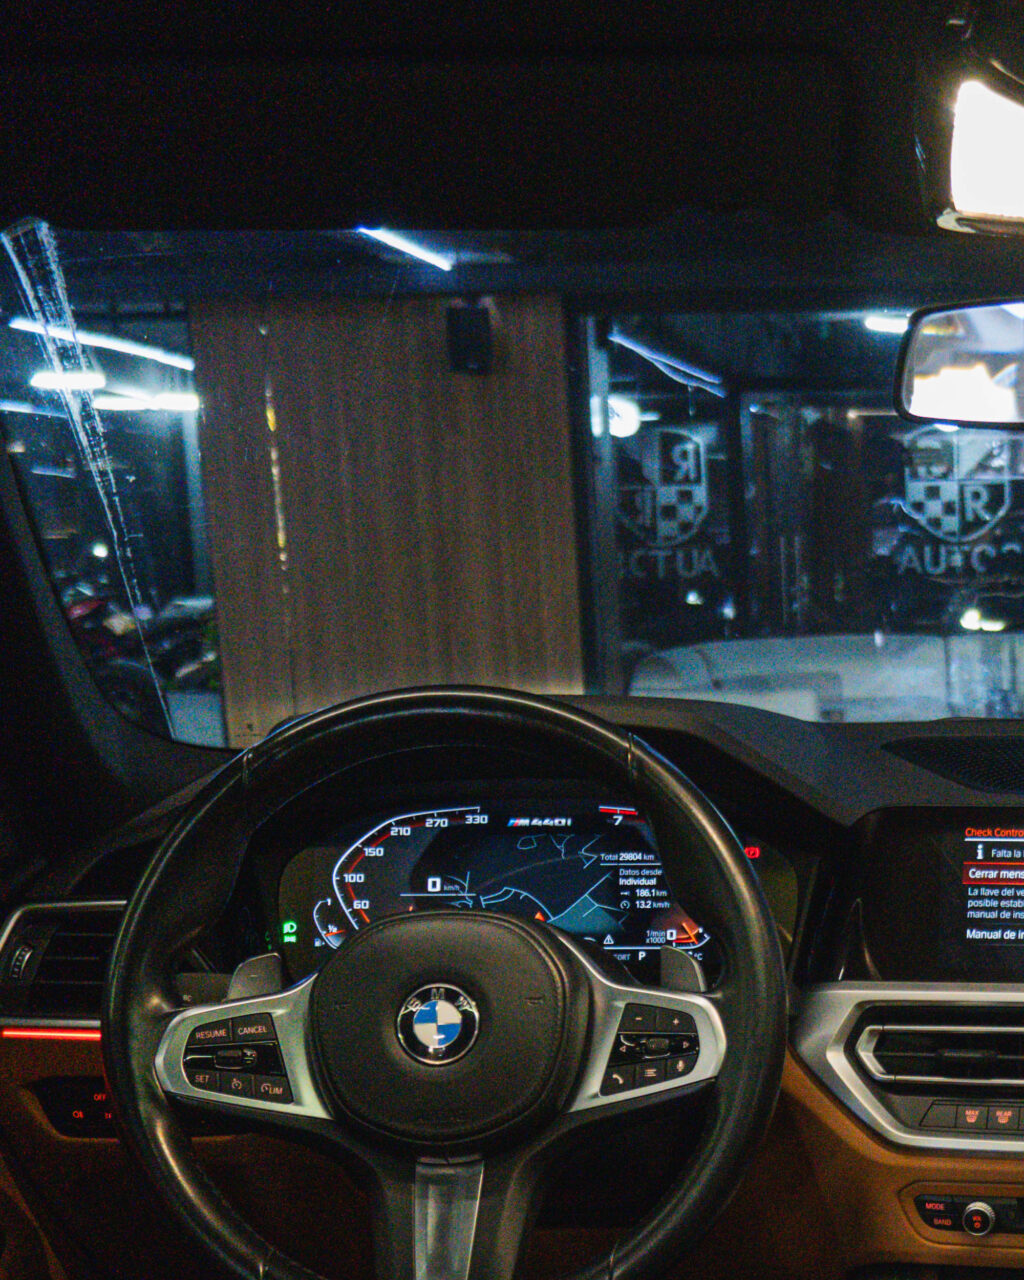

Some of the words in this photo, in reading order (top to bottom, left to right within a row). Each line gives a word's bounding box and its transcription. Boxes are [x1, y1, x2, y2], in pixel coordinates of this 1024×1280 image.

[964, 486, 991, 522] R
[425, 818, 448, 828] 270
[465, 815, 488, 824] 330
[613, 815, 623, 825] 7
[390, 827, 411, 836] 210
[965, 828, 992, 837] Check
[363, 848, 384, 857] 150
[619, 853, 642, 861] 29804
[991, 850, 1012, 858] Falta
[1014, 850, 1021, 858] la
[641, 868, 662, 876] desde
[969, 868, 998, 879] Cerrar
[343, 874, 364, 883] 100
[619, 878, 657, 886] Individual
[968, 887, 979, 896] La
[980, 887, 999, 896] llave
[1001, 888, 1014, 897] del
[353, 900, 369, 909] 60
[636, 901, 651, 909] 13.2
[968, 899, 998, 909] posible
[967, 910, 998, 919] manual
[1000, 910, 1011, 919] de
[967, 929, 1001, 939] Manual
[1004, 930, 1016, 939] de
[639, 951, 646, 960] P
[196, 1029, 227, 1039] RESUME
[238, 1026, 267, 1036] CANCEL
[195, 1075, 209, 1083] SET
[269, 1086, 283, 1095] LIM
[925, 1202, 945, 1211] MODE
